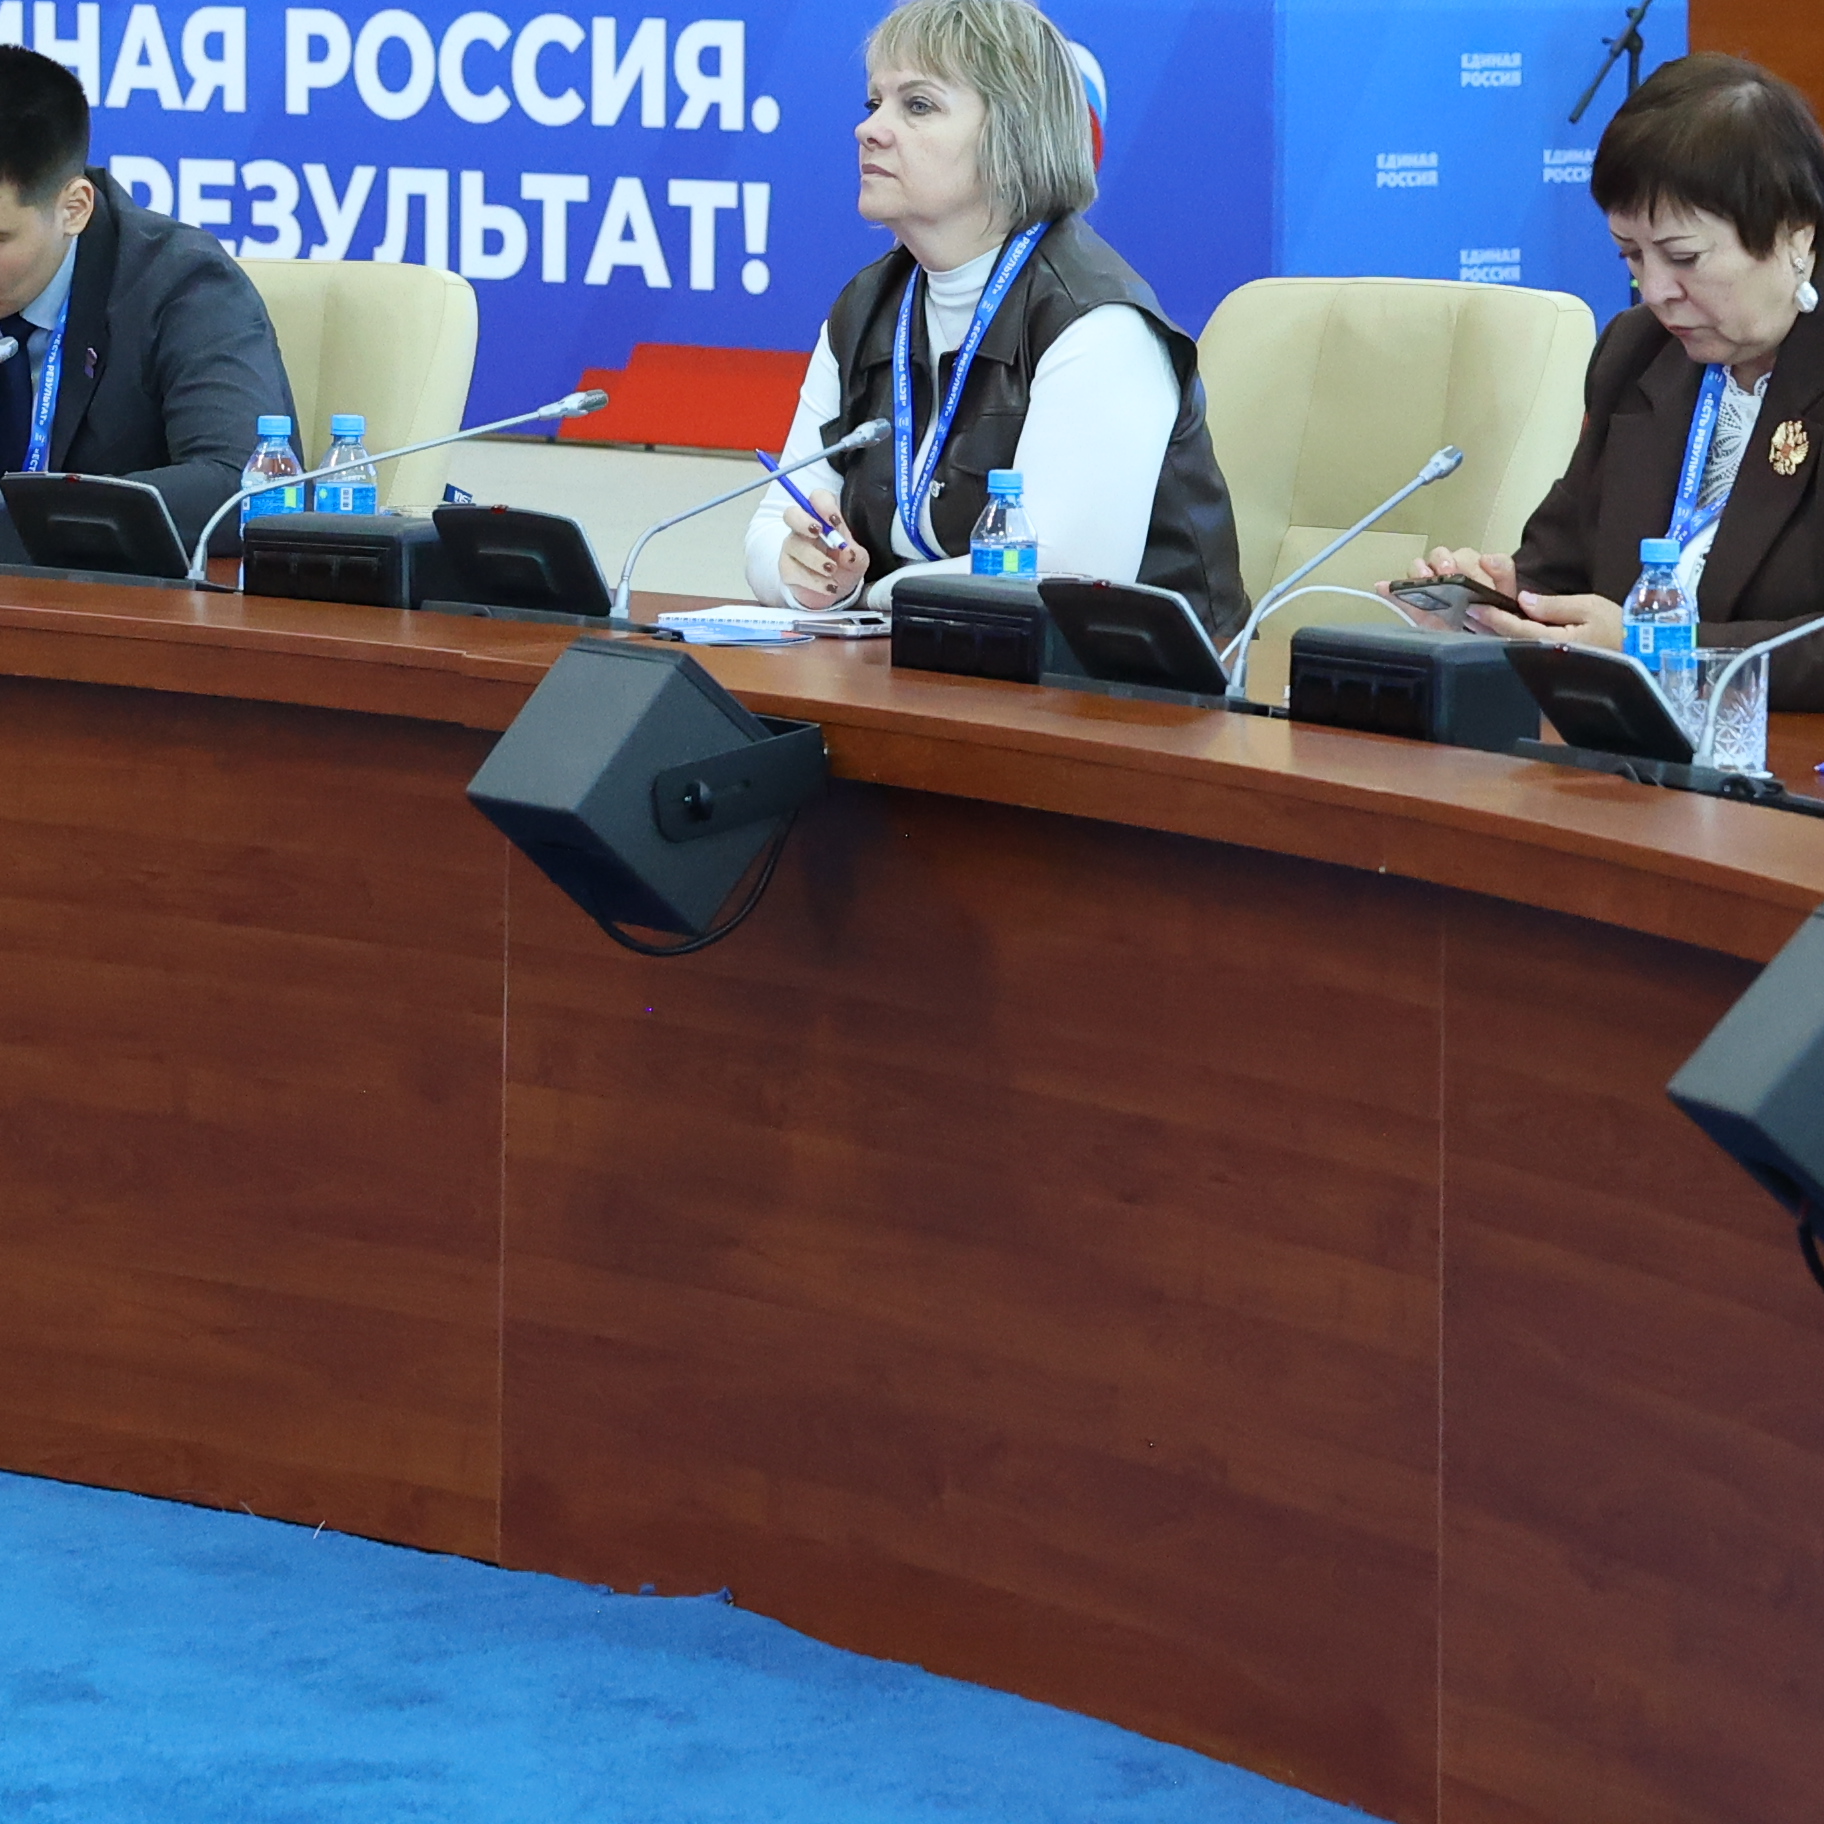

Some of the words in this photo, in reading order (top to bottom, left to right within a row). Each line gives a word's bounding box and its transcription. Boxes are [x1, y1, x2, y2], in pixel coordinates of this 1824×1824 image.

[1461, 52, 1522, 69] ЕДИНАЯ
[285, 7, 780, 133] РОССИЯ.
[1461, 70, 1522, 87] РОССИЯ
[1377, 152, 1438, 169] ЕДИНАЯ
[1543, 149, 1597, 164] ЕДИНА
[1377, 170, 1438, 188] РОССИЯ
[1543, 166, 1593, 183] РОССИ
[1459, 248, 1521, 264] ЕДИНАЯ
[1459, 265, 1521, 282] РОССИЯ
